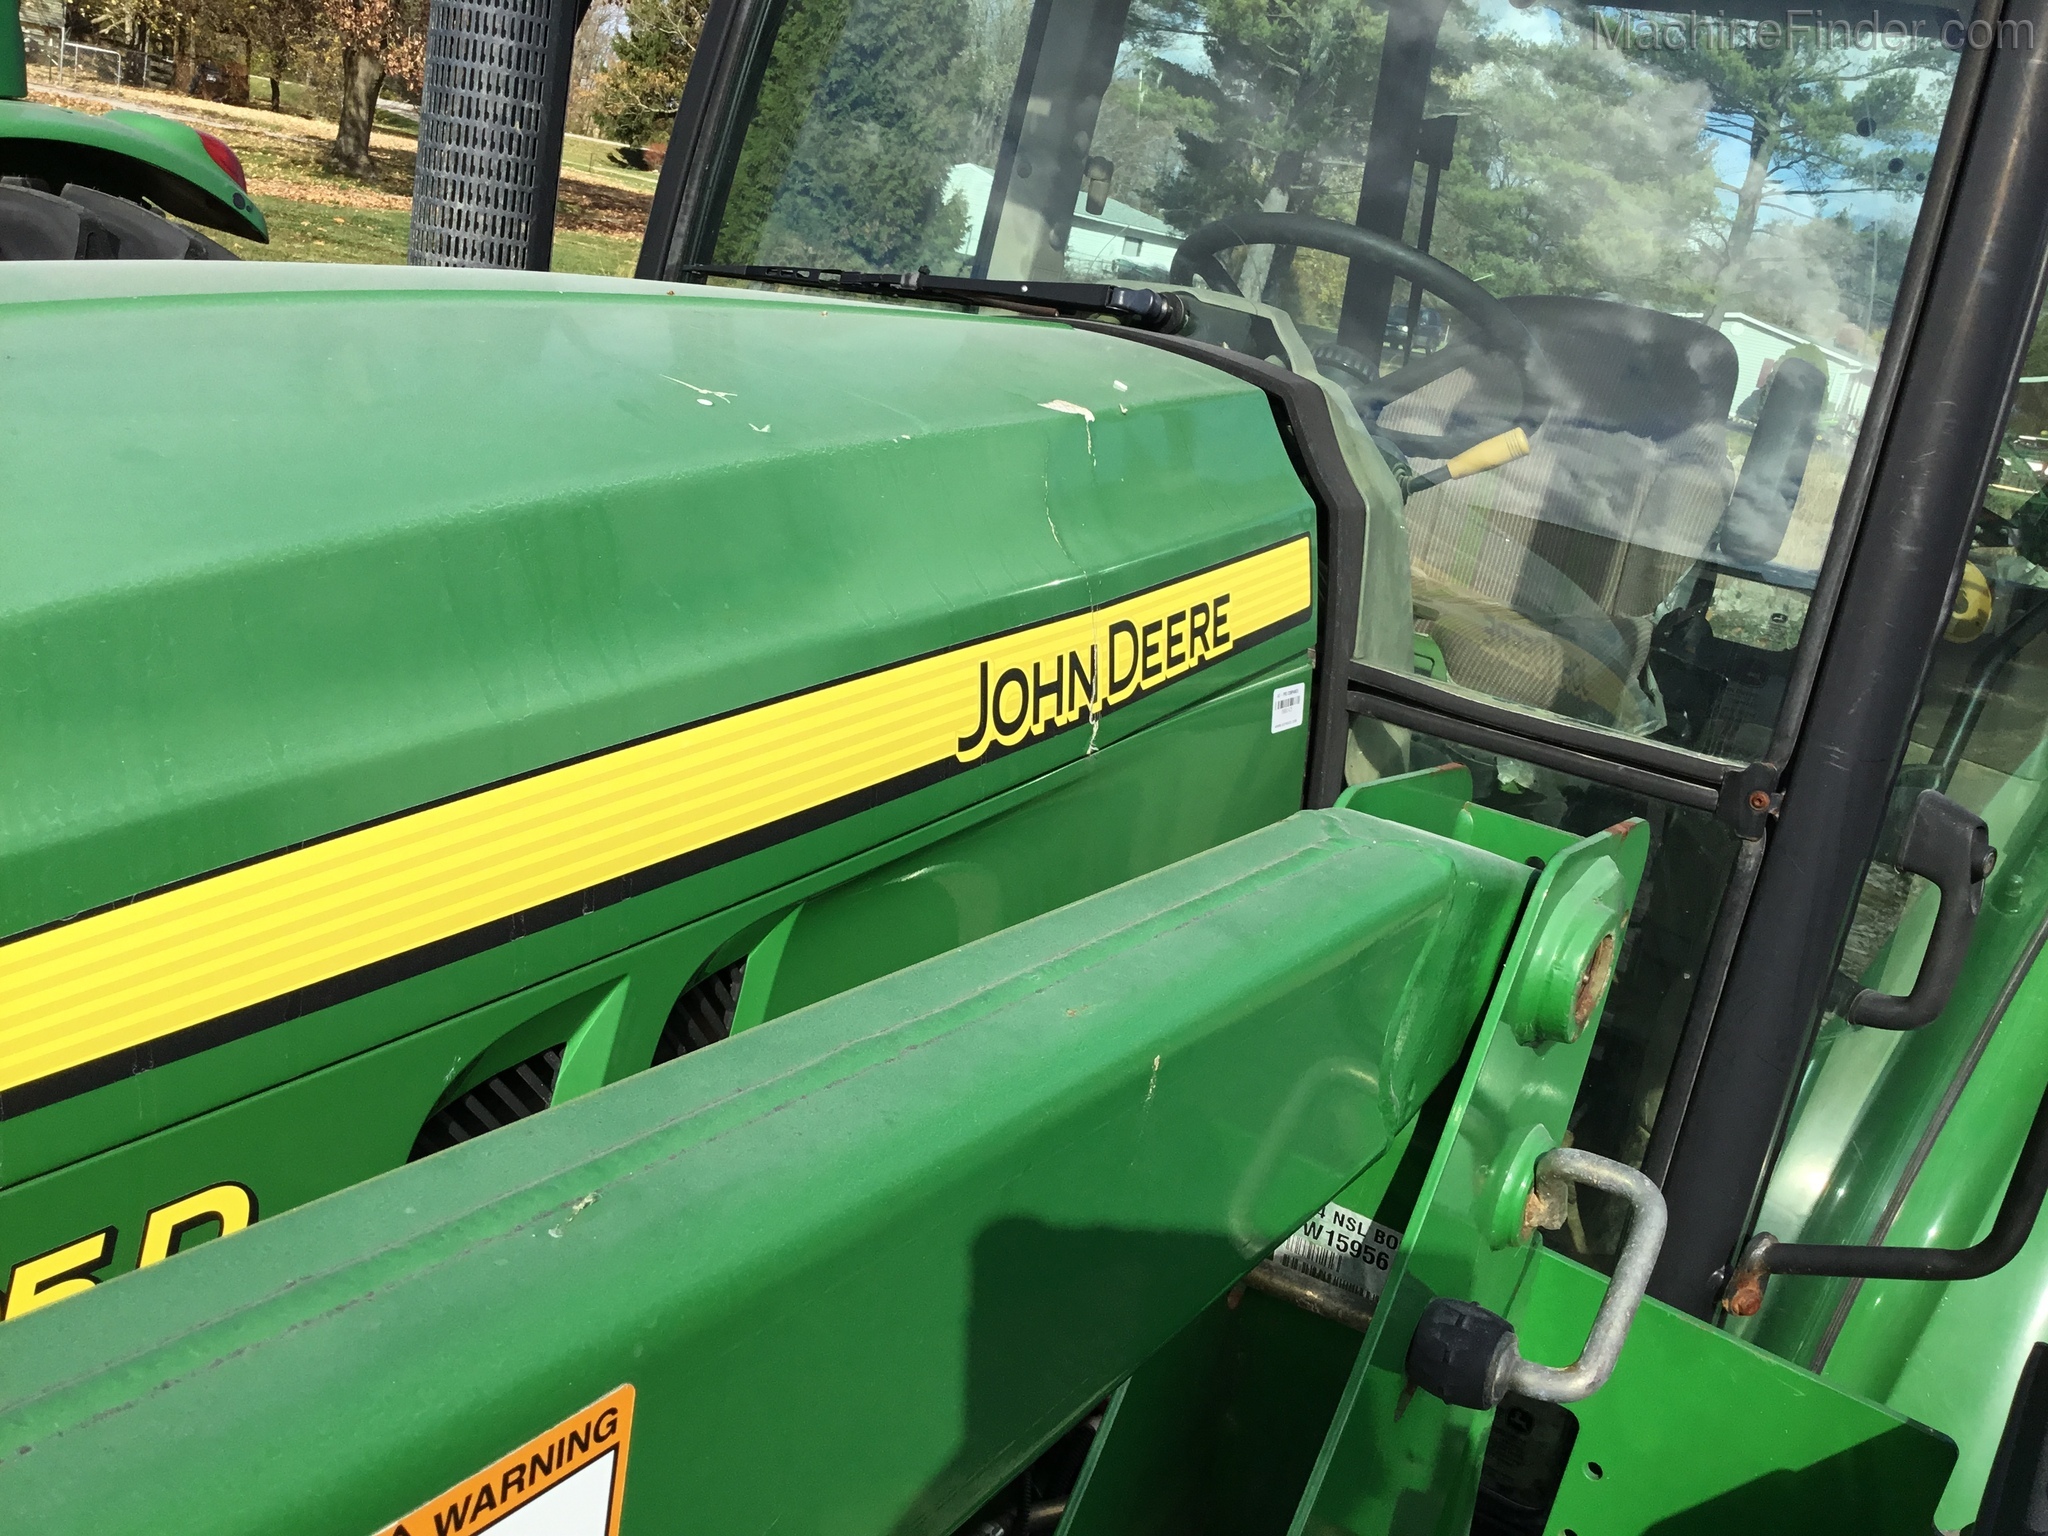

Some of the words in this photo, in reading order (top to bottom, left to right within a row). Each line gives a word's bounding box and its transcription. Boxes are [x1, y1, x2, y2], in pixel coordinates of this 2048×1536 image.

[956, 642, 1100, 756] JOHN
[1108, 592, 1232, 700] DEERE
[1333, 1210, 1366, 1237] NSL
[433, 1407, 619, 1536] WARNING
